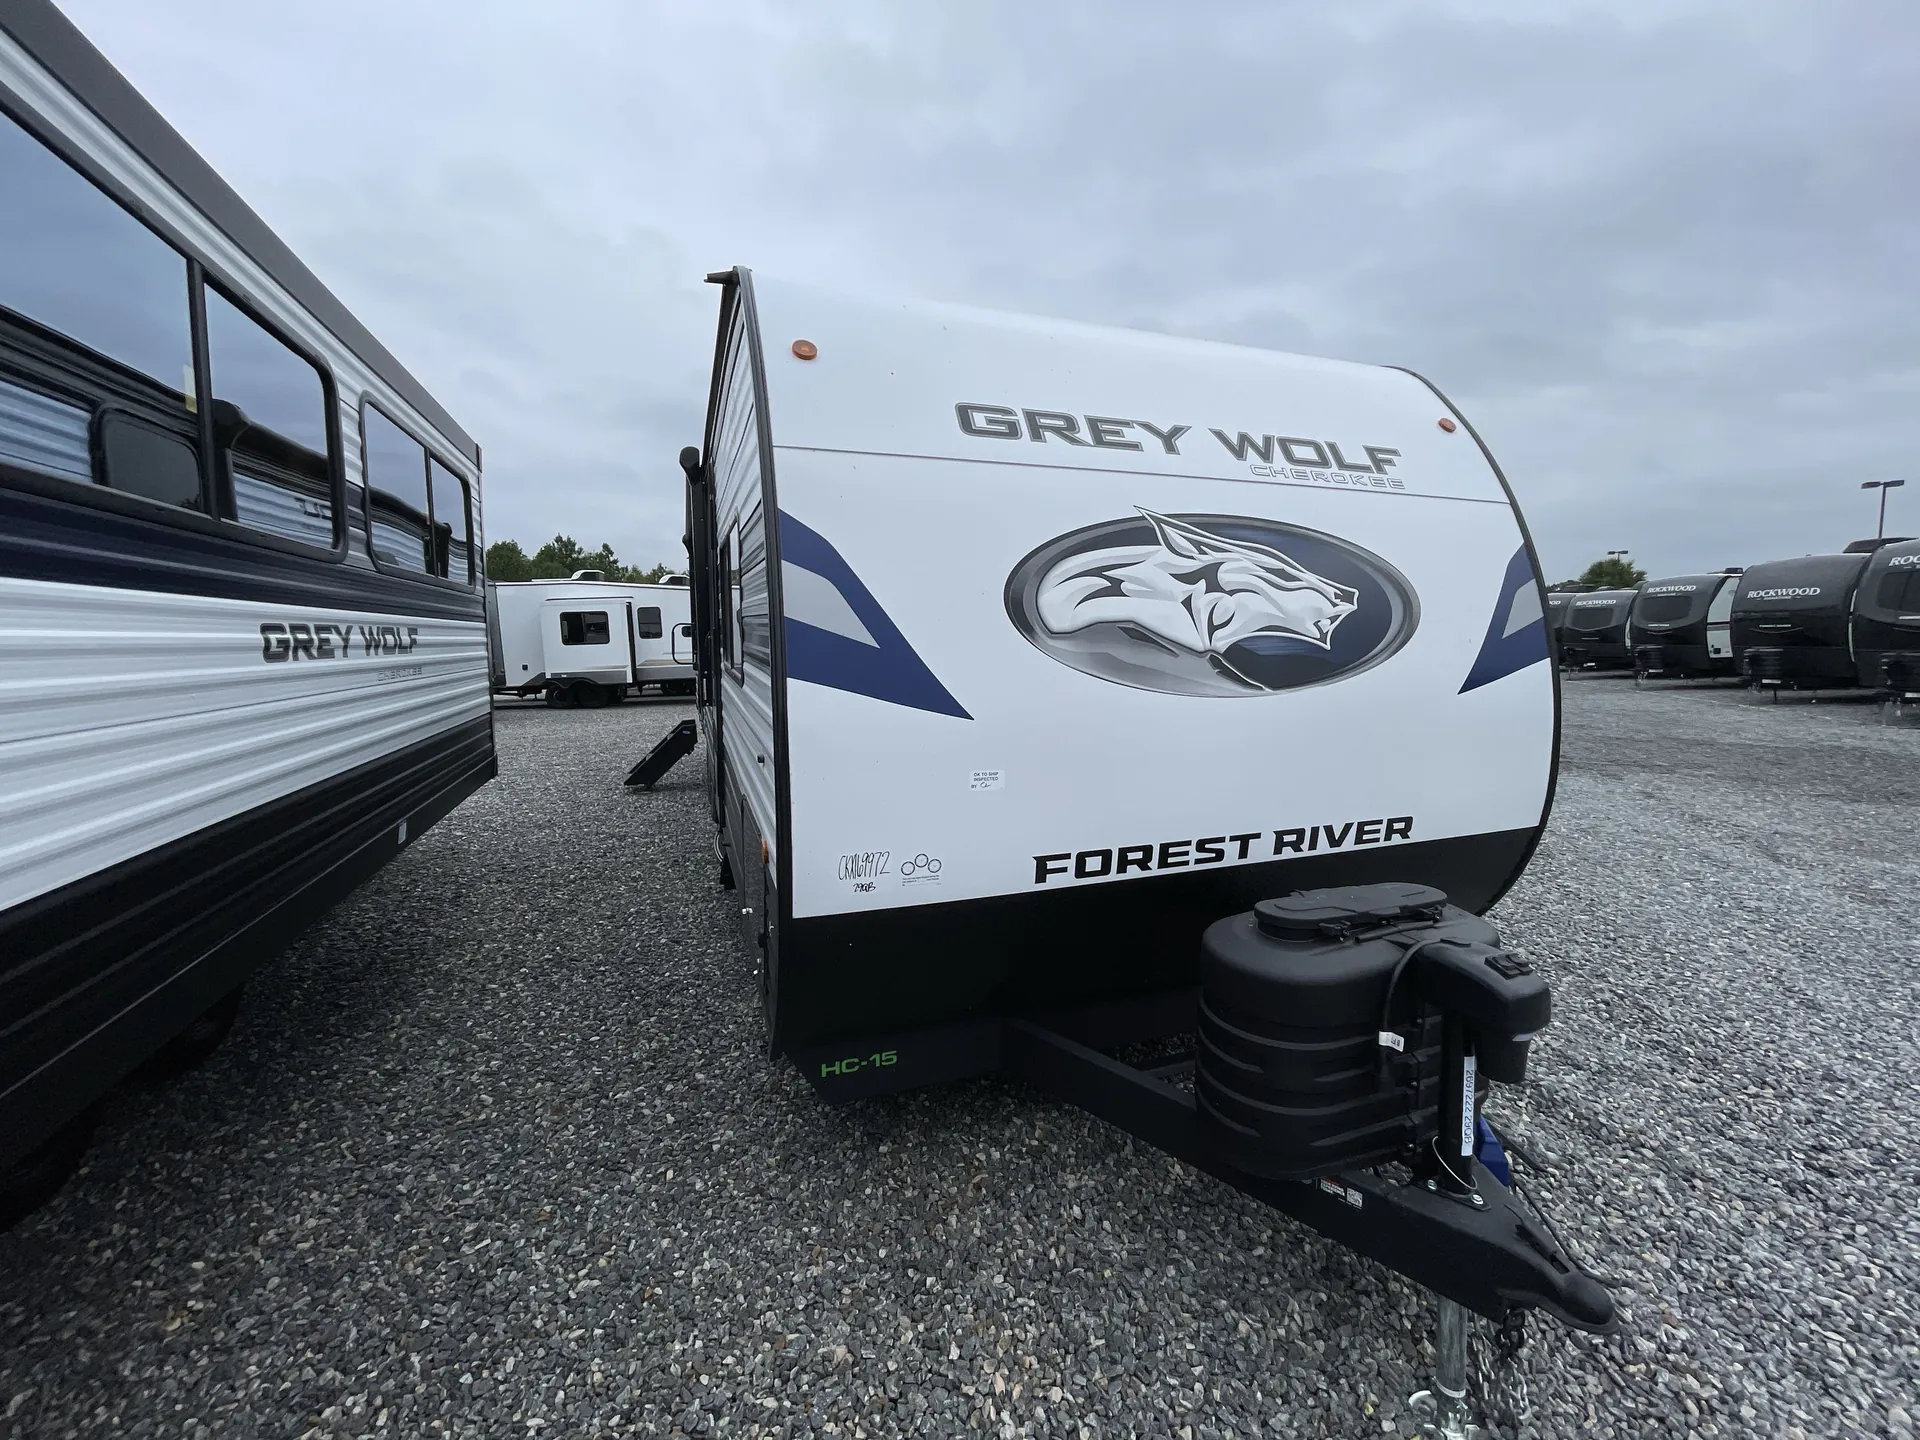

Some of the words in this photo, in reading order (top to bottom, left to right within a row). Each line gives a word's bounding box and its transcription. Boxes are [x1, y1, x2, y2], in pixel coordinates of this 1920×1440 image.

[953, 401, 1192, 455] GREY
[1207, 427, 1402, 474] WOLF
[1249, 463, 1406, 489] CHEROKEE
[1646, 584, 1697, 594] ROCKWOOD
[1746, 587, 1821, 599] ROCKWOOD
[259, 622, 353, 664] GREY
[359, 625, 418, 657] WOLF
[1032, 832, 1262, 885] FOREST
[1272, 815, 1414, 856] RIVER
[821, 1050, 898, 1078] HC-15
[1463, 1115, 1473, 1144] 29QB
